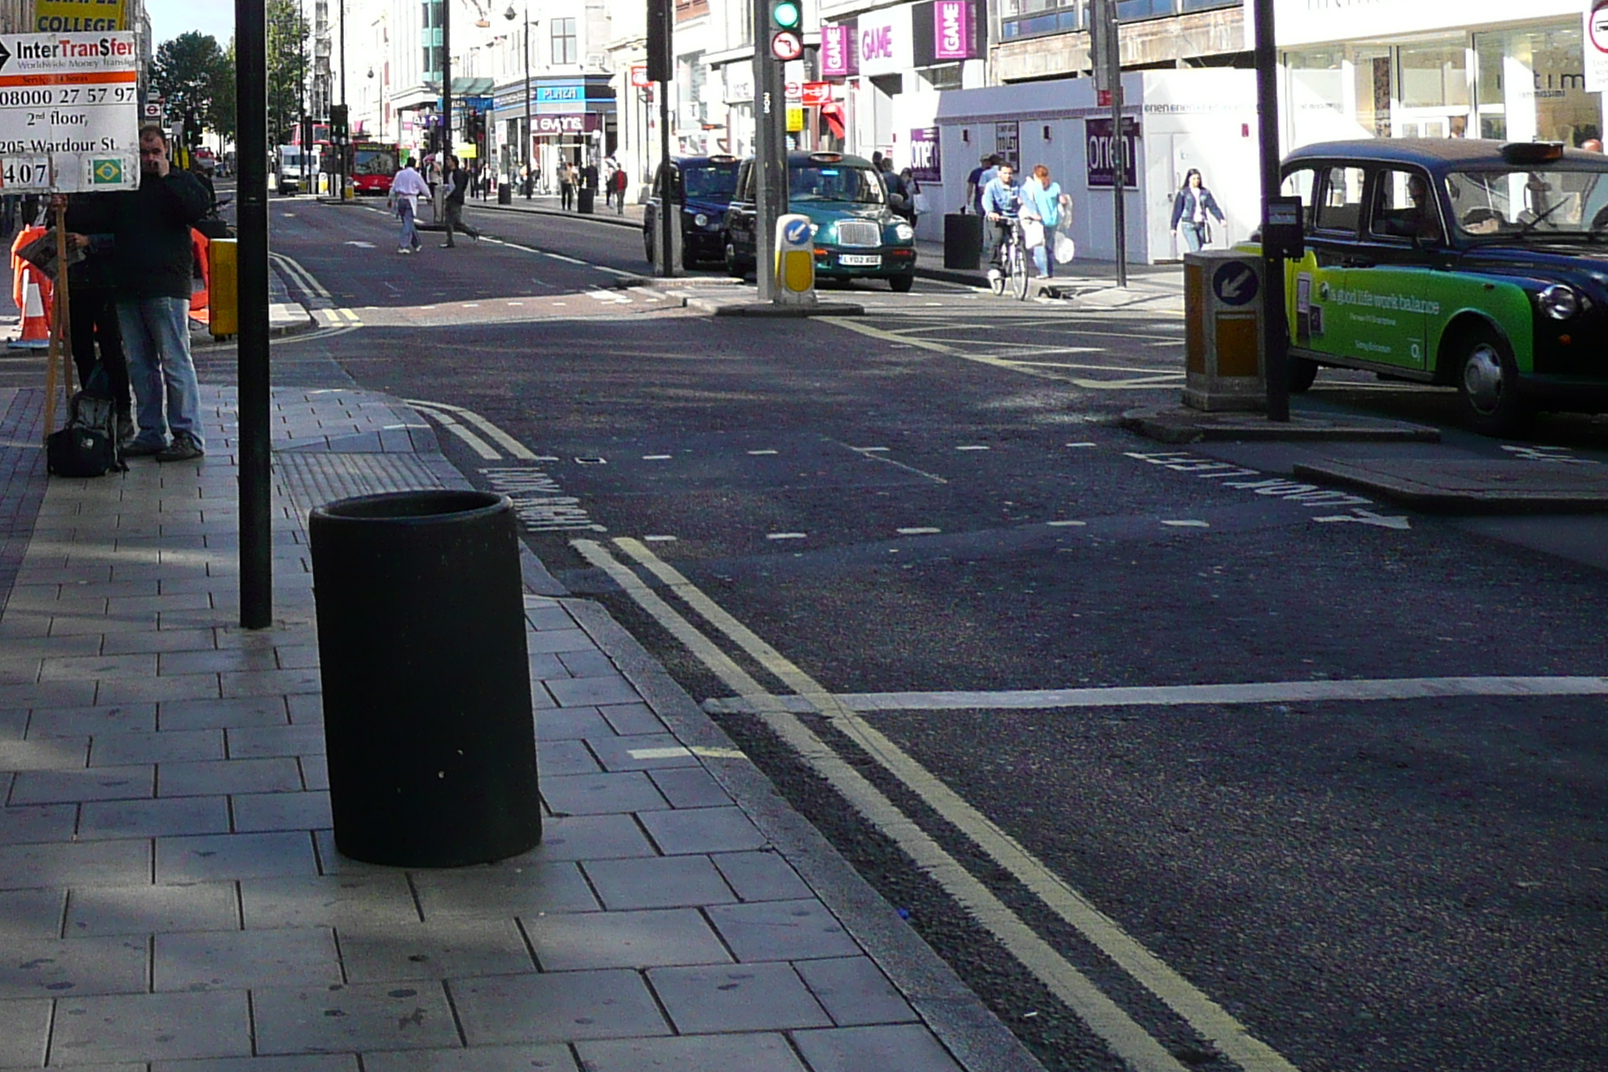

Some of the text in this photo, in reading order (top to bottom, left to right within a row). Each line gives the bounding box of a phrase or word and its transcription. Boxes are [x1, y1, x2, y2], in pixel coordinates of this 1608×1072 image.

[37, 15, 116, 32] COLLEGE
[943, 3, 959, 51] GAME
[827, 24, 841, 69] GAME
[862, 25, 892, 62] GAME
[17, 60, 66, 70] Worldwide
[68, 58, 98, 69] Money
[0, 87, 135, 106] 08000 27 57 97
[544, 88, 577, 100] PLAZA
[27, 110, 89, 127] 2nd floor,
[31, 137, 96, 154] Wardour
[1399, 295, 1440, 315] balance
